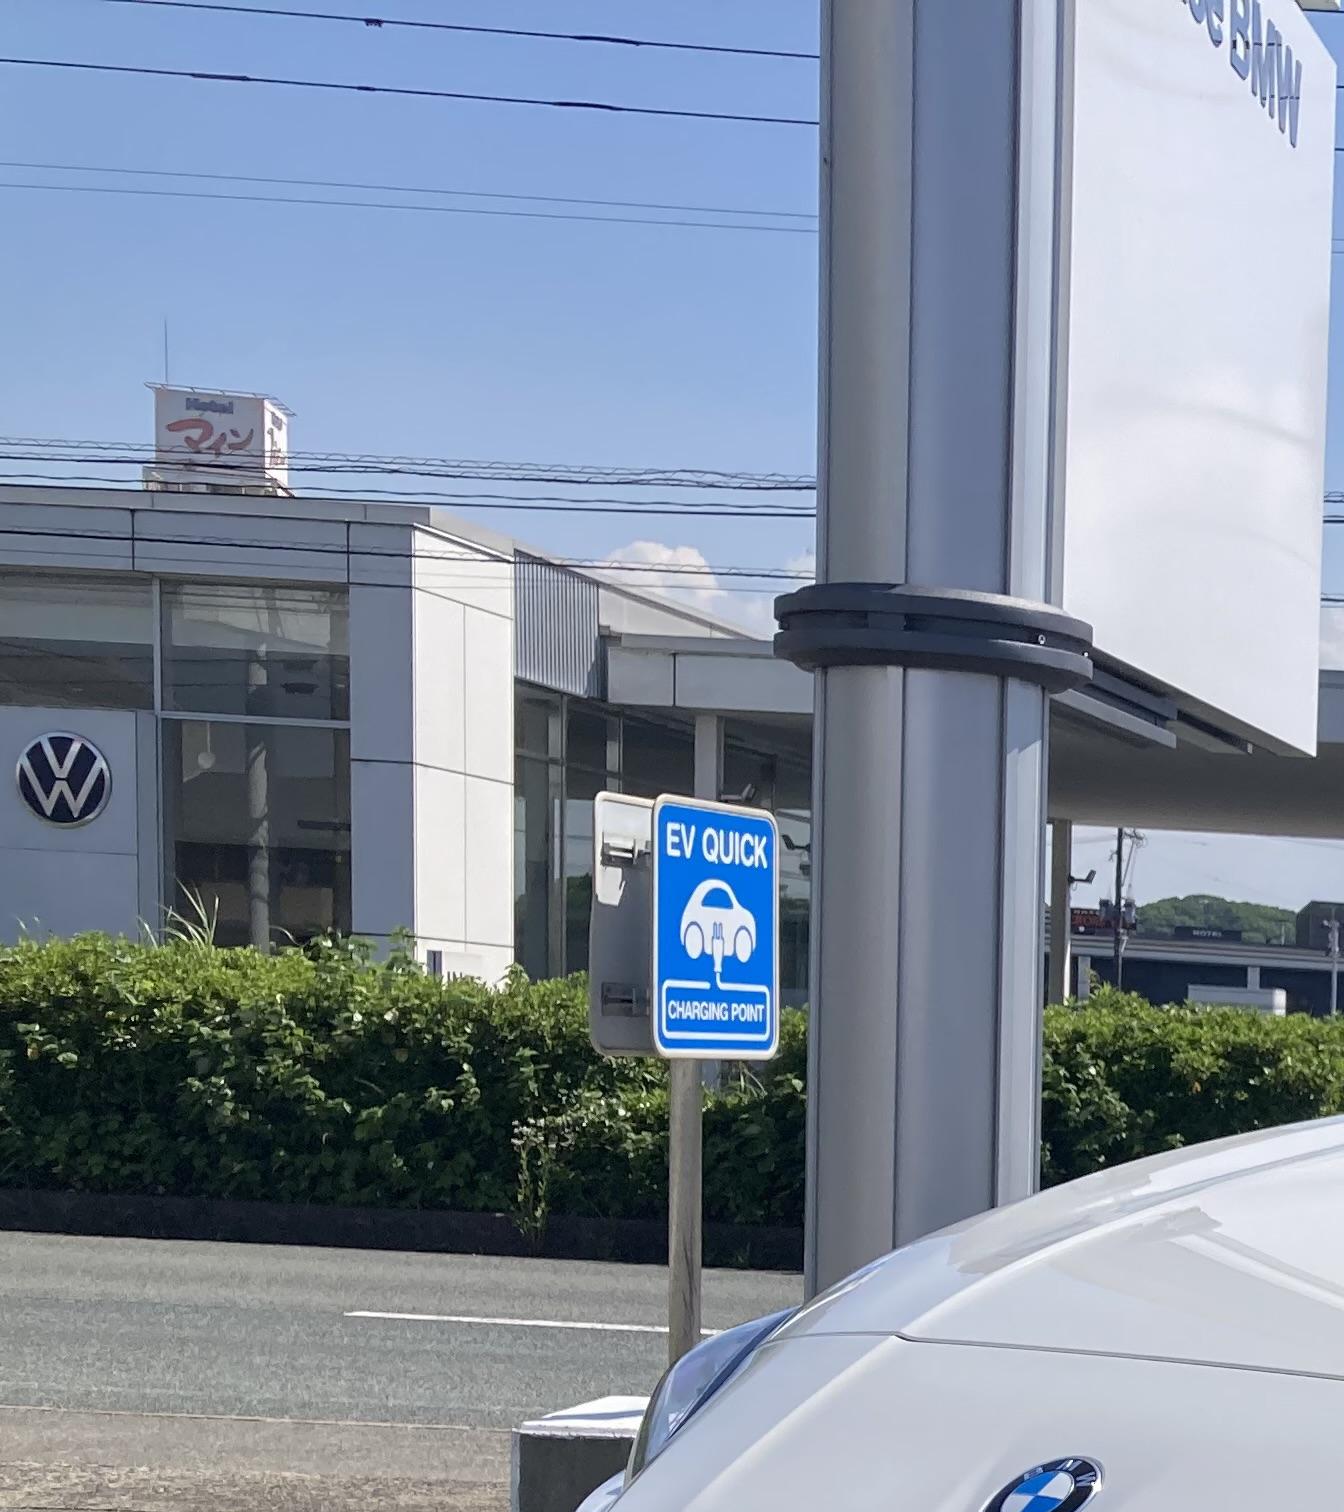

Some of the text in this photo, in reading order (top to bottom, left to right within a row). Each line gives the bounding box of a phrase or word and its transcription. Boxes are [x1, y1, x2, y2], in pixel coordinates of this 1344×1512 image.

[1230, 0, 1302, 148] BMW
[666, 822, 768, 869] EV QUICK
[667, 1000, 765, 1023] CHARGING POINT
